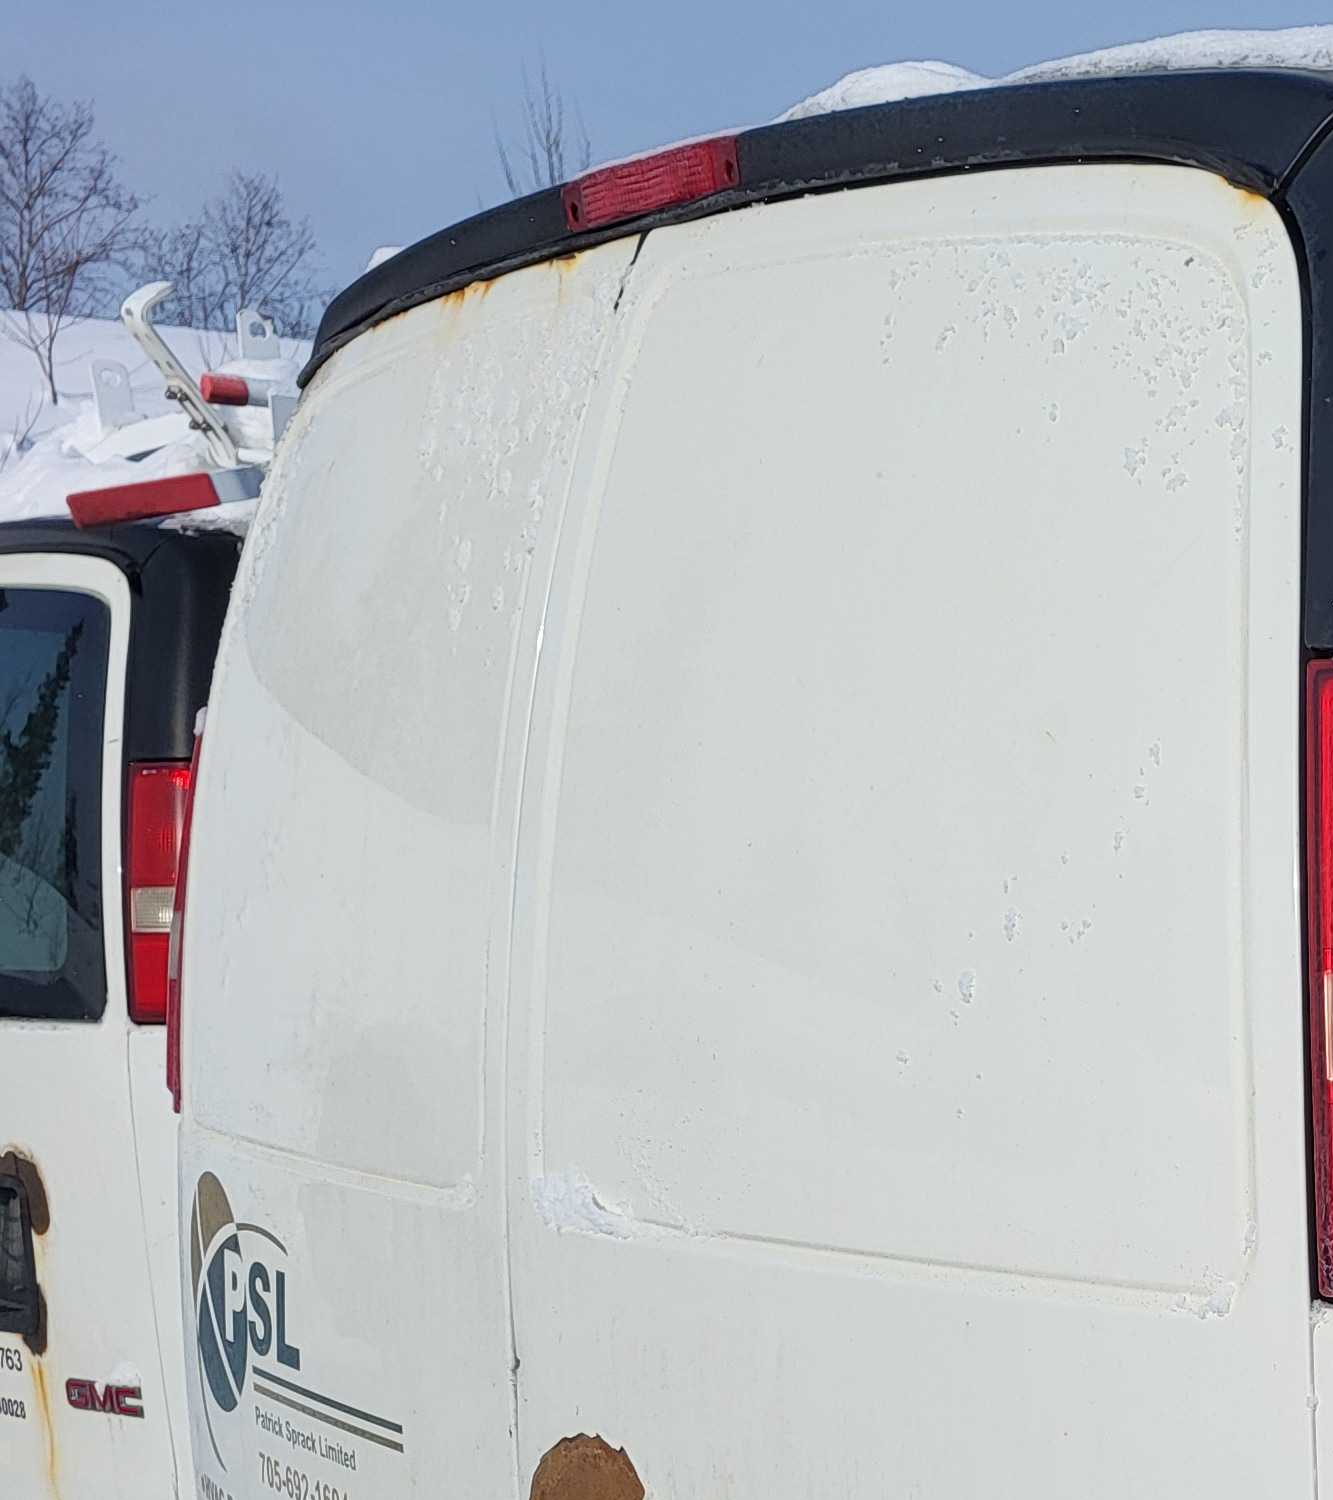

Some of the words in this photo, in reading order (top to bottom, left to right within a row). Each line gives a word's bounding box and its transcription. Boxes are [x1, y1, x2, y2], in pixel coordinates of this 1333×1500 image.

[224, 1249, 300, 1371] PSL
[0, 1397, 26, 1419] 0028
[66, 1378, 144, 1418] GMC
[255, 1406, 283, 1439] Patrick
[285, 1420, 317, 1453] Sprack
[319, 1431, 357, 1471] Limited
